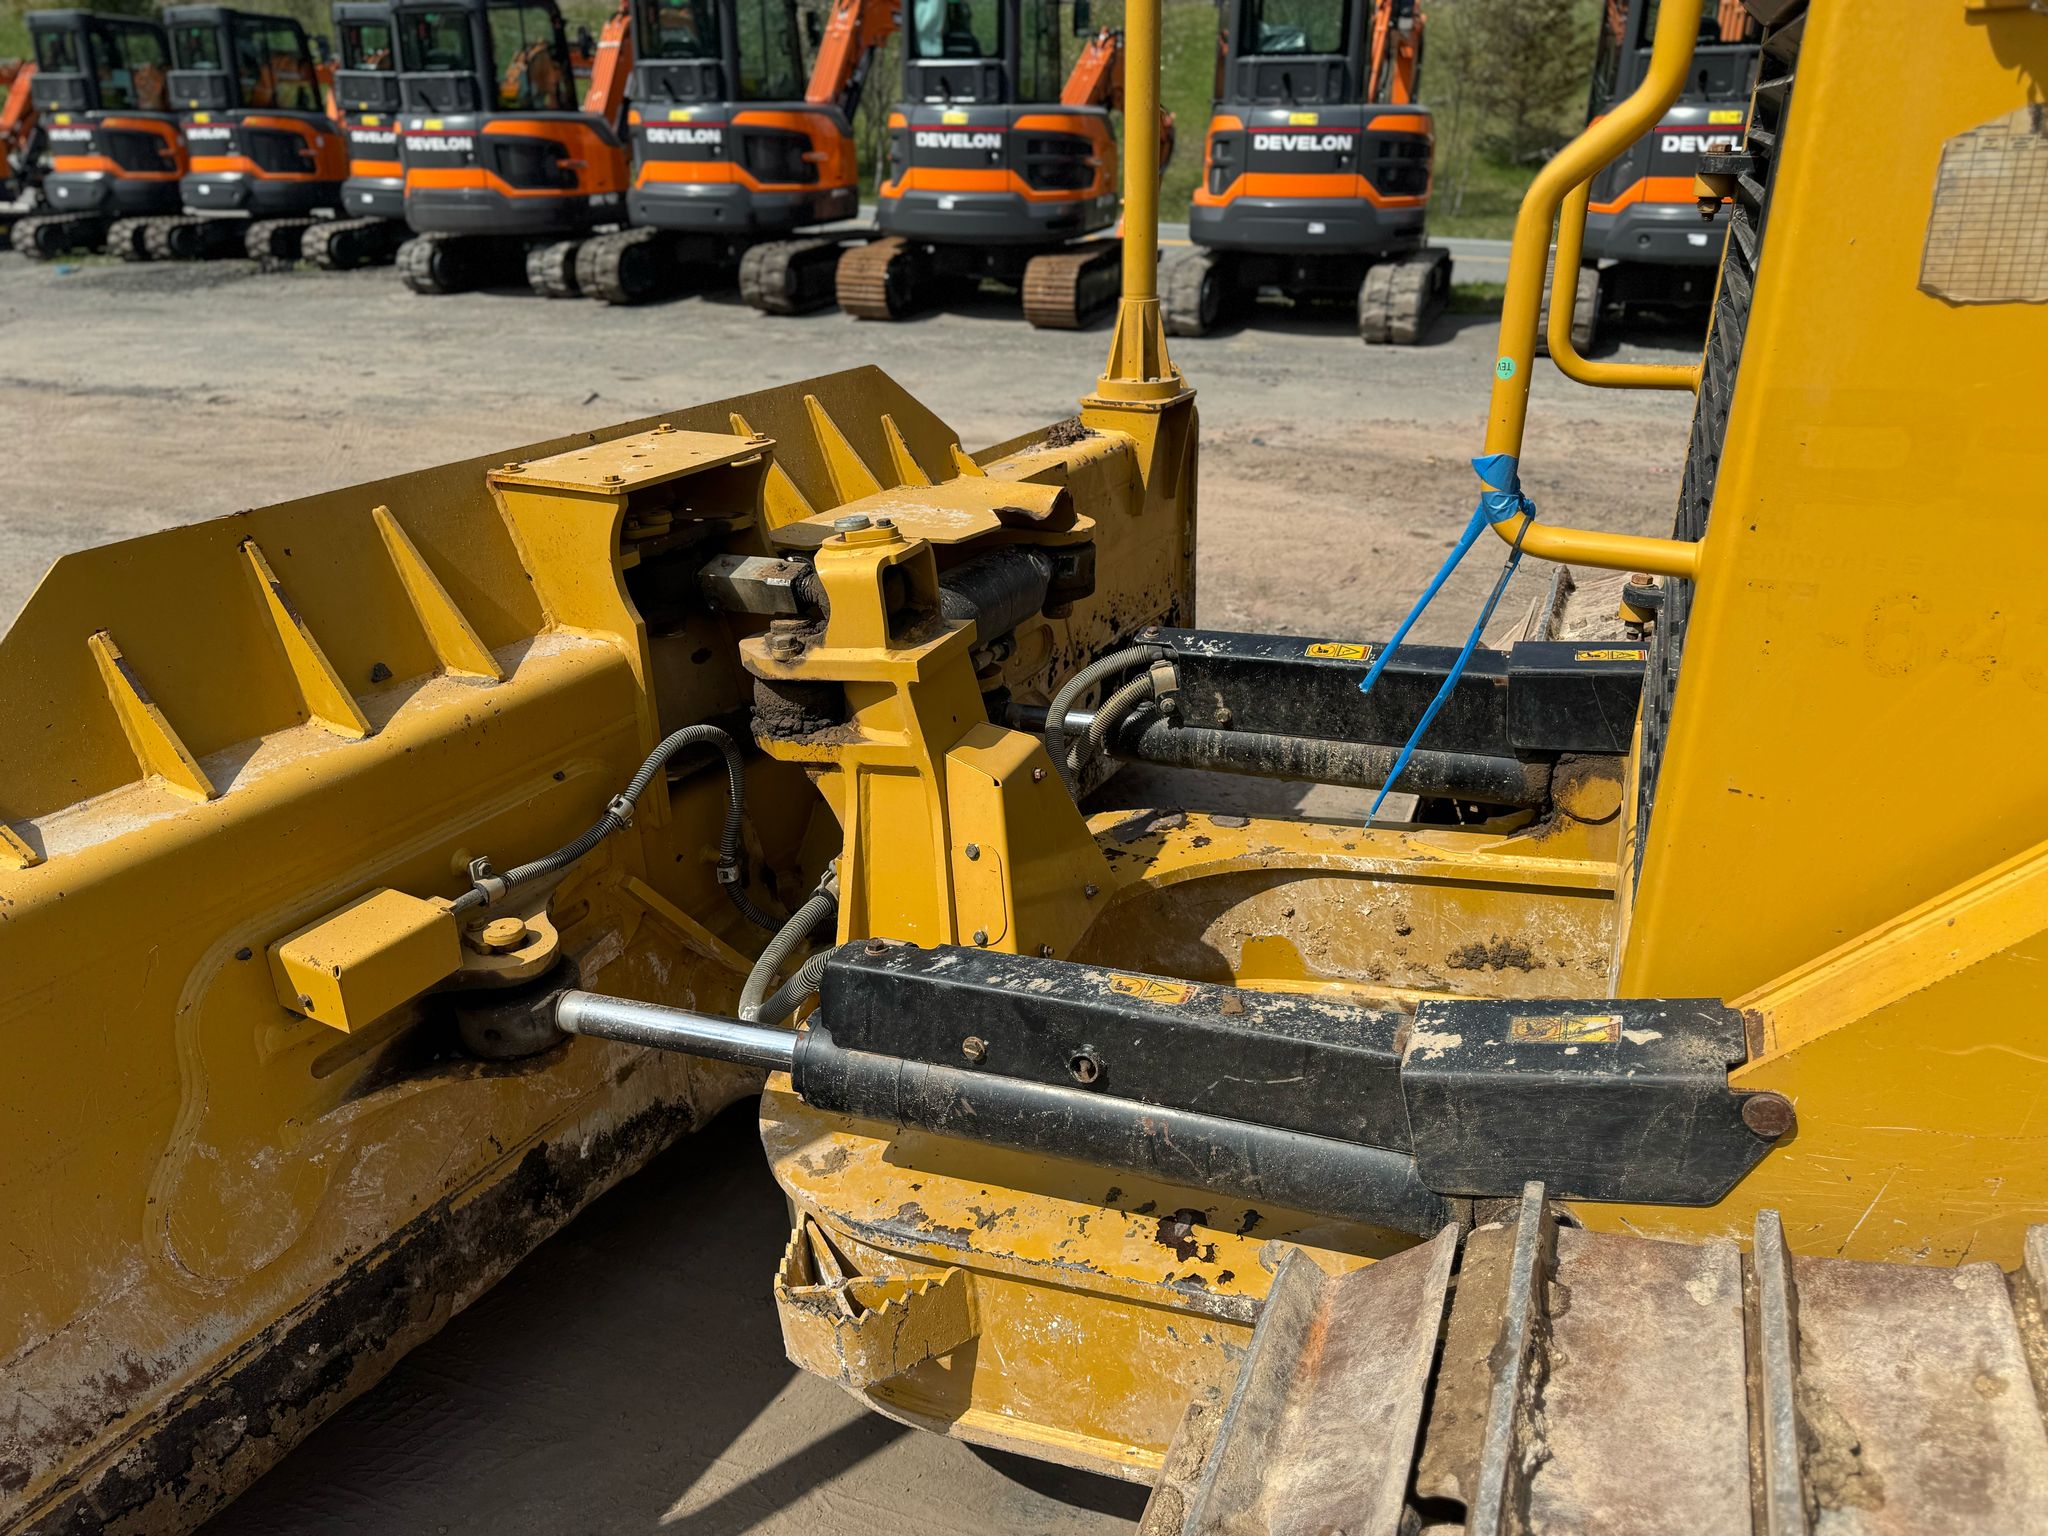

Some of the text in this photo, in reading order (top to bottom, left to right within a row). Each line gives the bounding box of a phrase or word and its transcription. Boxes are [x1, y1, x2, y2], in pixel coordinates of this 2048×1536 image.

[646, 128, 722, 143] DEVELON
[915, 132, 1002, 148] DEVELON
[1253, 134, 1353, 151] DEVELON
